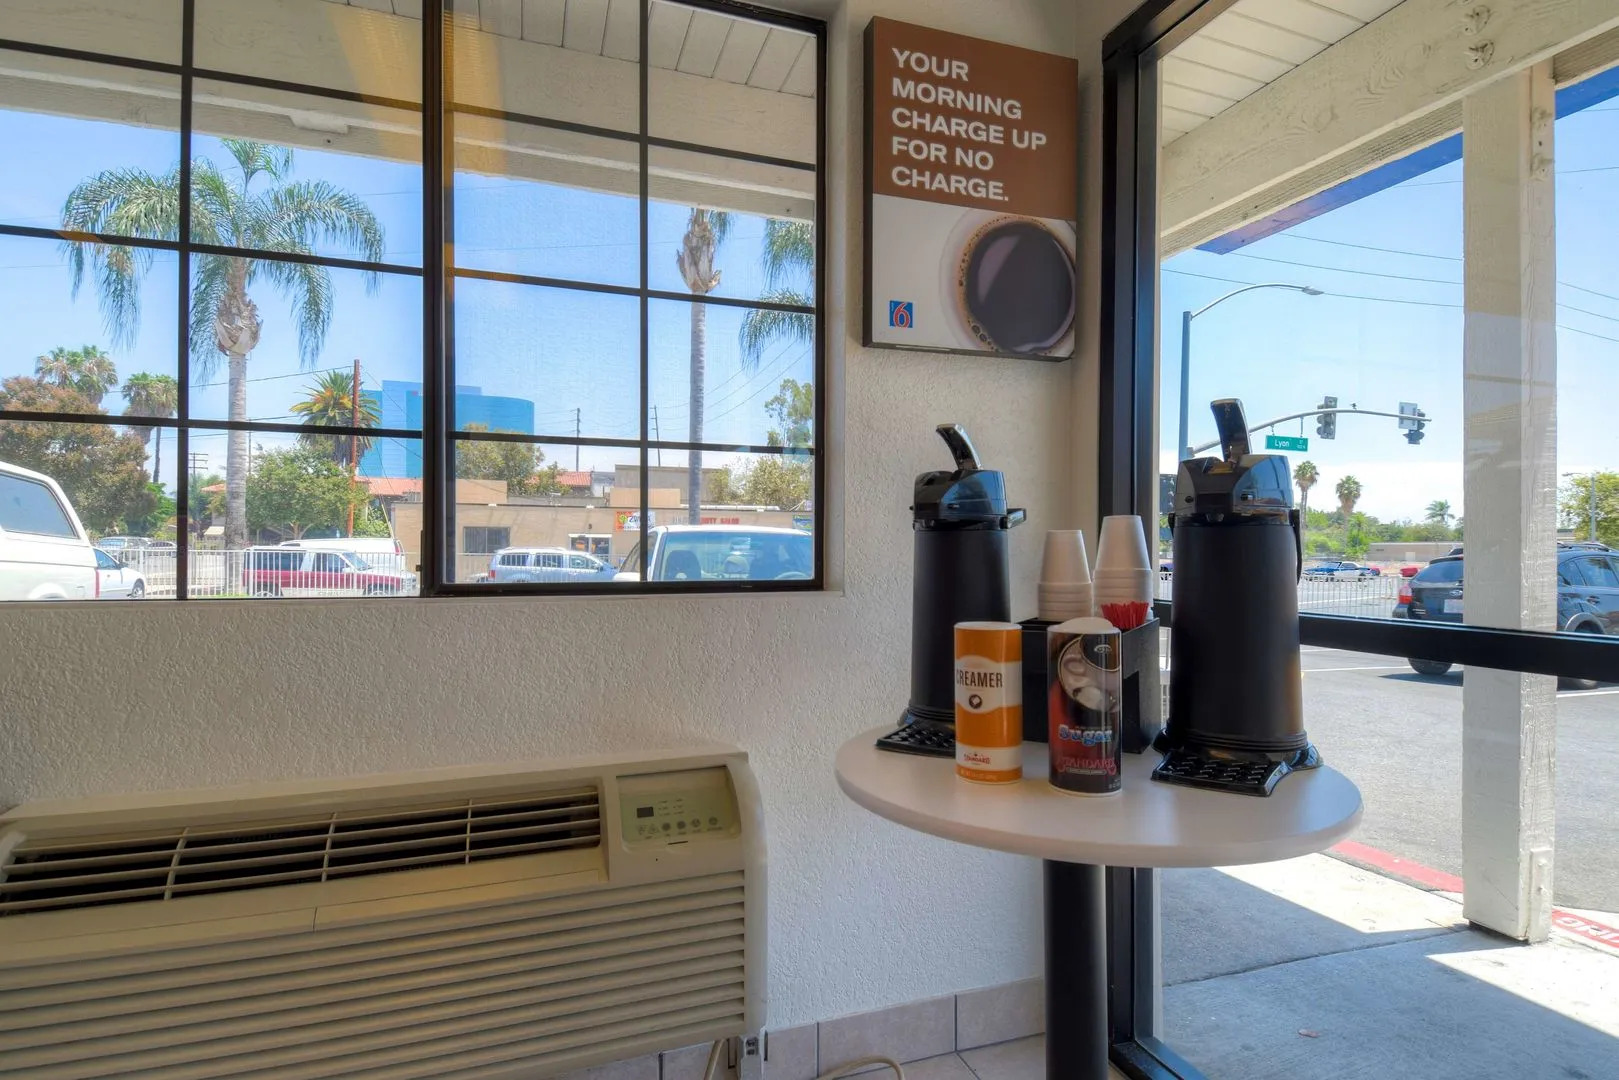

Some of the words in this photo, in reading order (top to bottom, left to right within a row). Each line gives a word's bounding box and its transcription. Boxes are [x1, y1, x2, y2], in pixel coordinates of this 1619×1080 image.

[892, 48, 969, 81] YOUR
[892, 77, 1022, 120] MORNING
[891, 107, 1005, 145] CHARGE
[1013, 128, 1047, 150] UP
[892, 136, 947, 163] FOR
[955, 147, 994, 171] NO
[891, 166, 1009, 201] CHARGE.
[893, 303, 911, 328] 6
[1274, 439, 1290, 448] Lyon
[1058, 724, 1112, 747] Sugar
